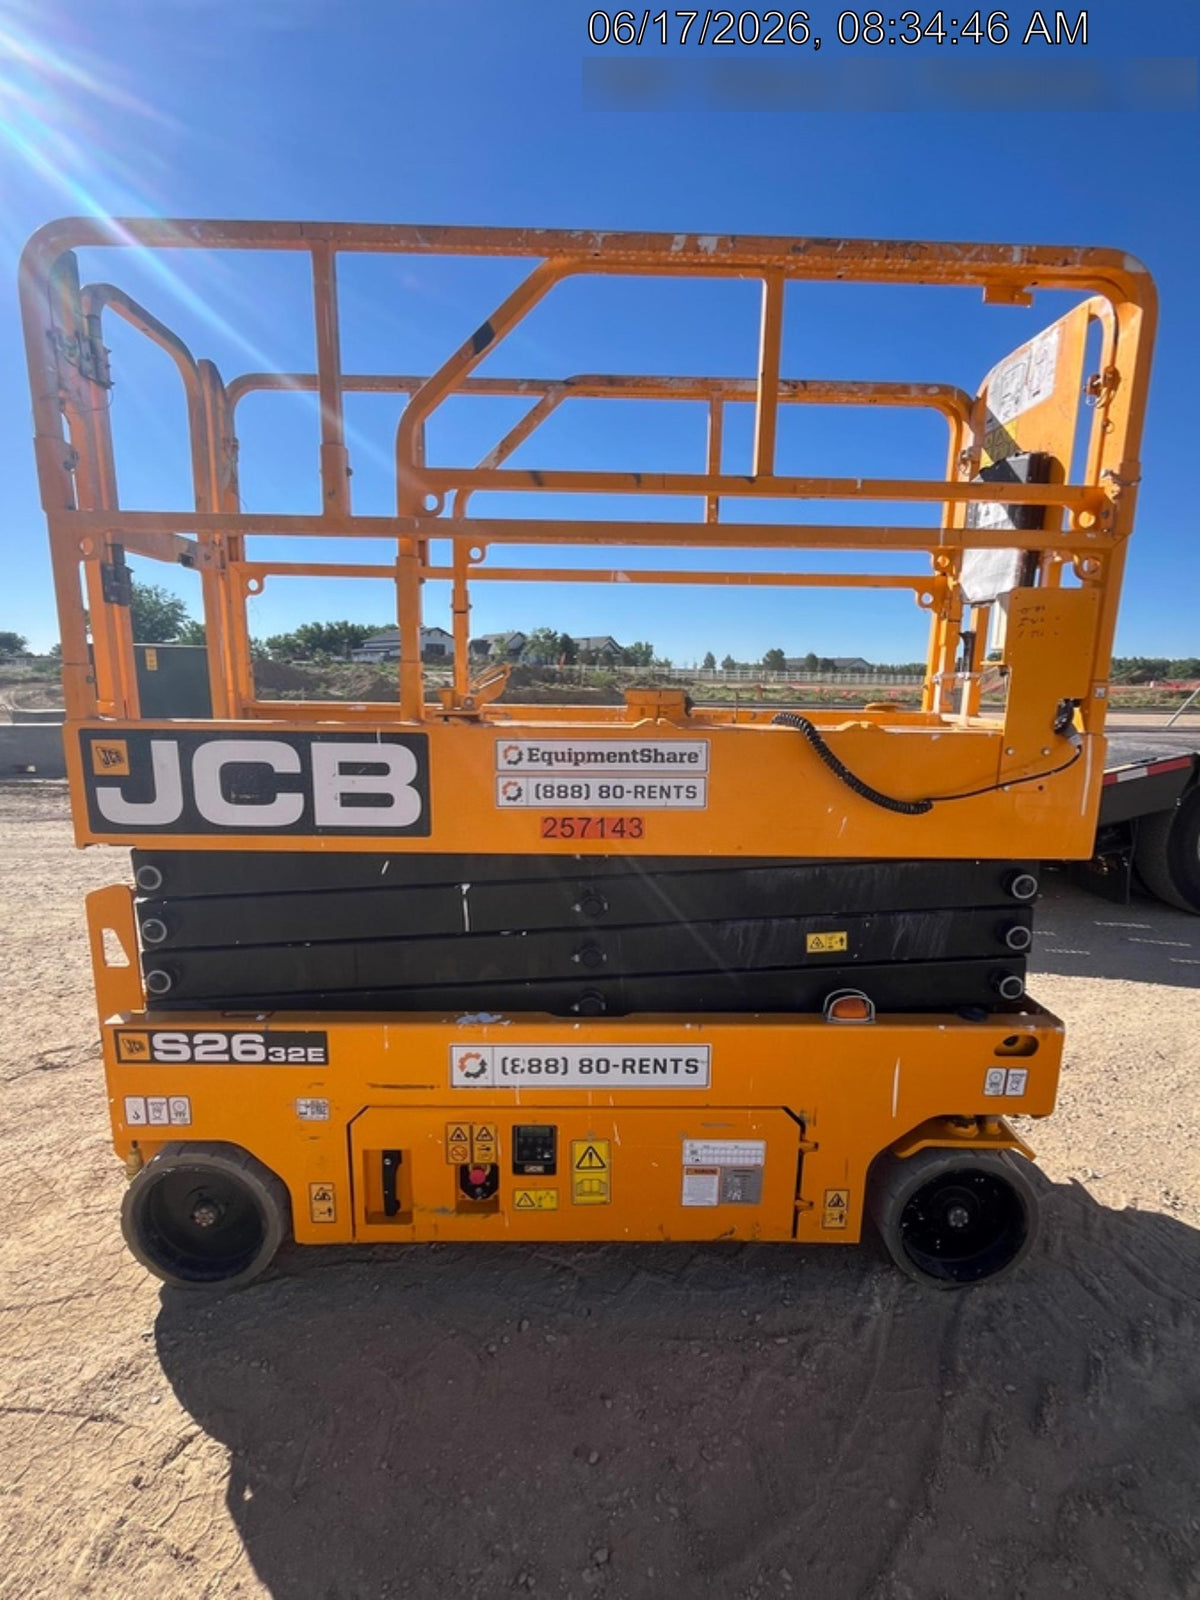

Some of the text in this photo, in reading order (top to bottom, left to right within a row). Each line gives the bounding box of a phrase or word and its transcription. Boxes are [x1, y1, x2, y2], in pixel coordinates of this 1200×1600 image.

[527, 747, 699, 767] EquipmentShare
[95, 739, 422, 827] JCB
[534, 784, 698, 800] (888) 80-RENTS
[543, 817, 643, 839] 257143
[578, 1057, 699, 1075] 80-RENTS
